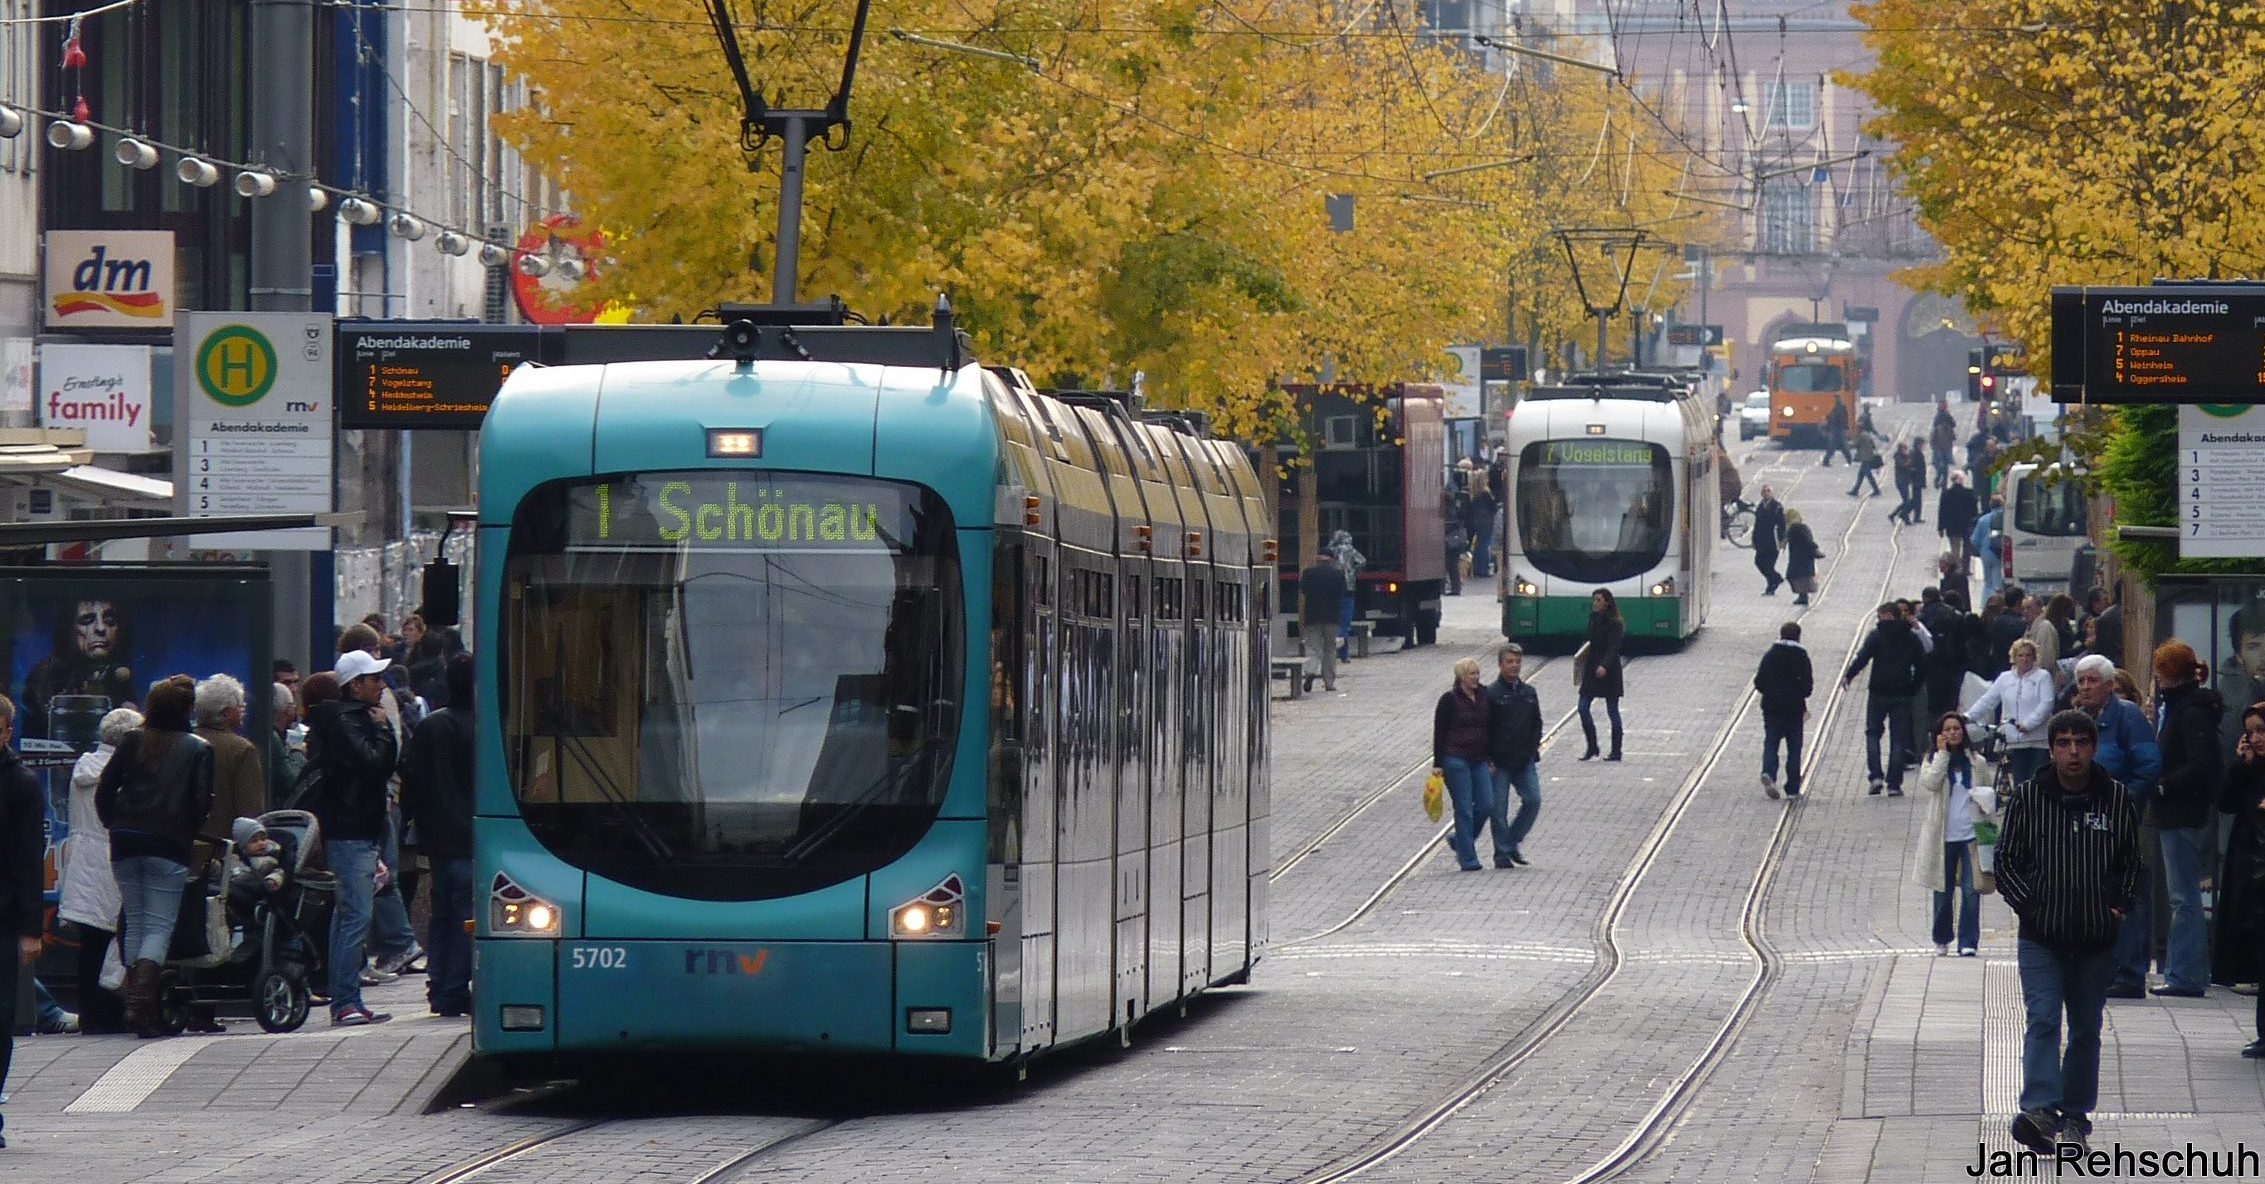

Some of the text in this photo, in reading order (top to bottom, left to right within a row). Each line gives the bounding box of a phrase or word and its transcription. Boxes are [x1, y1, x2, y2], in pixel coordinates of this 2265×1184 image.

[73, 245, 152, 291] dm
[2102, 300, 2228, 314] Abendakademie
[356, 336, 471, 349] Abendakademie
[2117, 332, 2214, 344] 1 Rheinau Bahnhof
[2115, 344, 2160, 357] 7 Oppau
[370, 365, 375, 375] 1
[381, 366, 419, 375] Schönau
[2115, 358, 2174, 370] 5 Weinheim
[368, 376, 432, 389] 7 Vogelstang
[2115, 372, 2124, 383] 4
[2129, 374, 2187, 384] Oggersheim
[368, 389, 376, 399] 4
[47, 391, 141, 428] family
[286, 401, 318, 413] rnv
[368, 401, 376, 411] 5
[210, 421, 309, 434] Abendakademie
[201, 440, 208, 453] 1
[1563, 445, 1652, 463] Vogelstang
[2193, 450, 2199, 464] 1
[200, 458, 209, 472] 3
[2191, 469, 2200, 482] 3
[200, 477, 209, 490] 4
[2191, 487, 2200, 500] 4
[200, 496, 209, 509] 5
[594, 482, 878, 541] 1 Schönau
[2191, 506, 2200, 518] 5
[2191, 523, 2200, 536] 7
[572, 948, 627, 969] 5702
[685, 949, 768, 975] rnv
